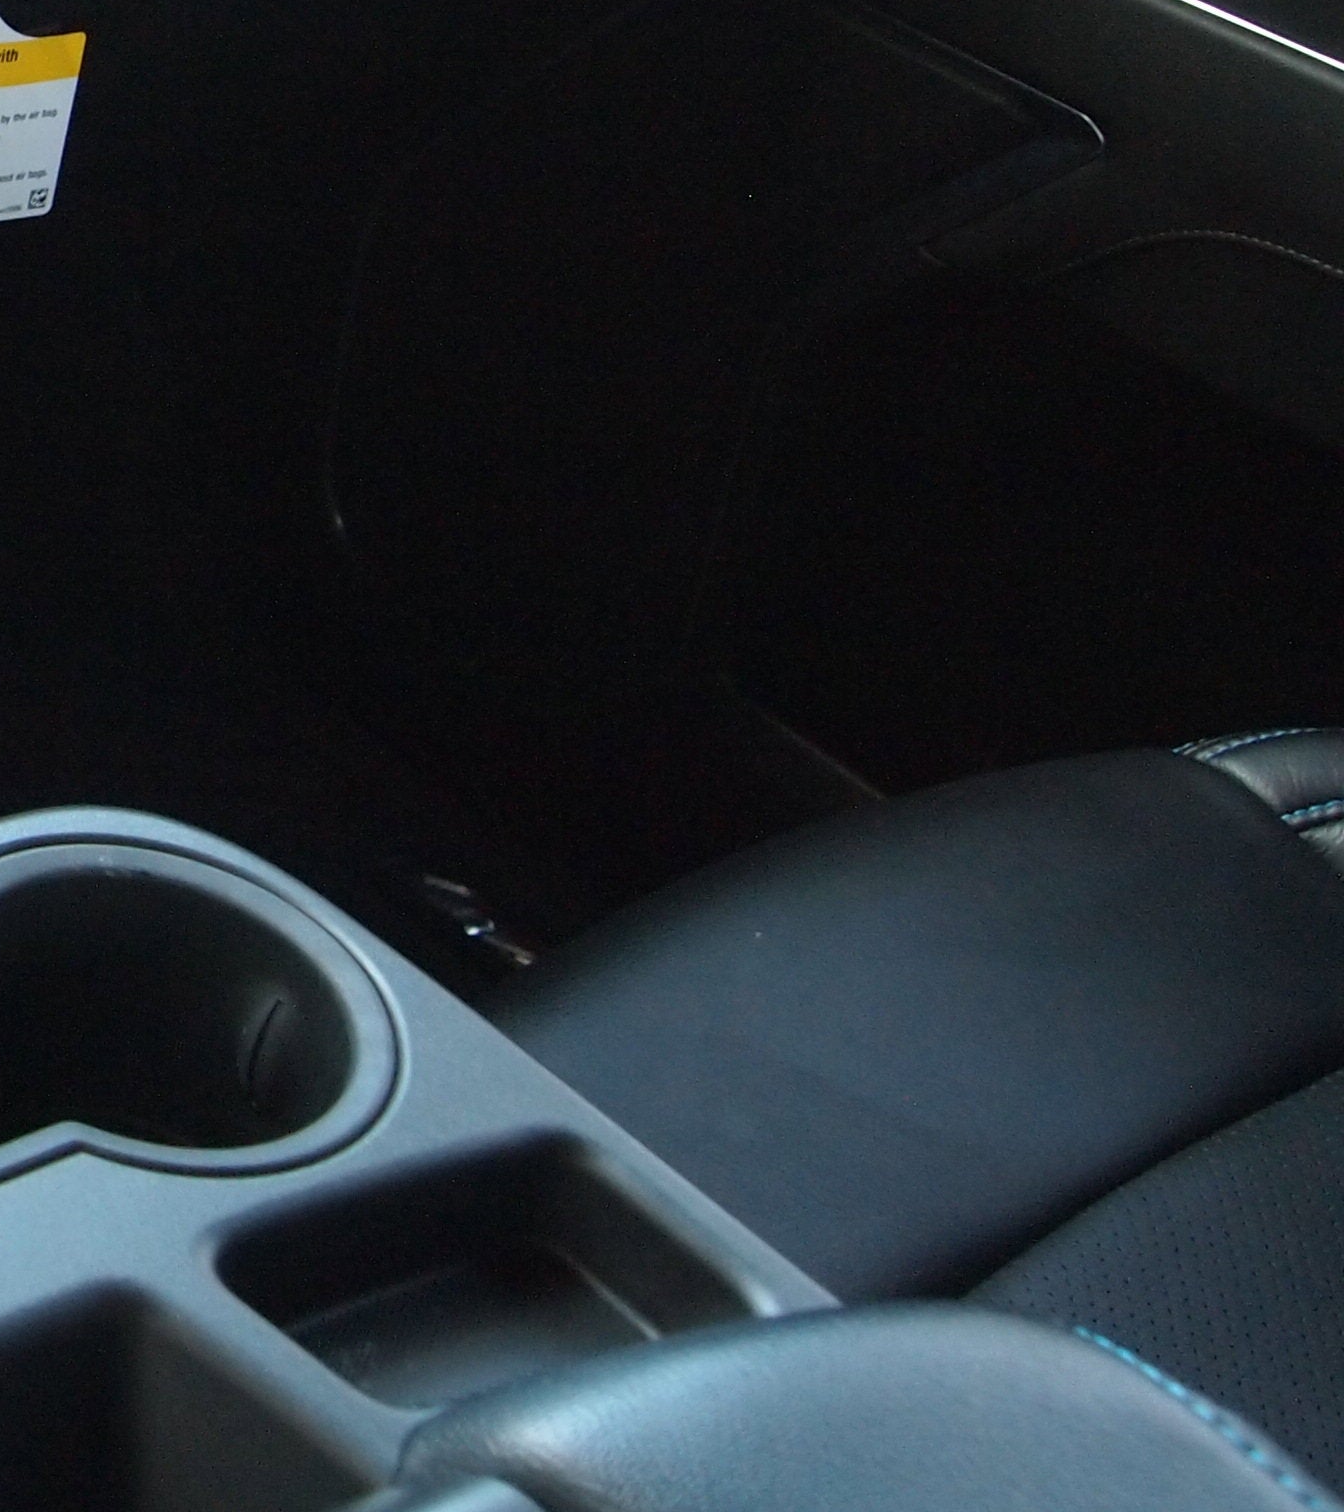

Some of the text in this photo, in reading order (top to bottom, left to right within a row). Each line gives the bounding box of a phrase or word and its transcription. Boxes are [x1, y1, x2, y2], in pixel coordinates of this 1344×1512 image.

[0, 115, 11, 125] by
[13, 112, 27, 122] the
[28, 110, 40, 120] air
